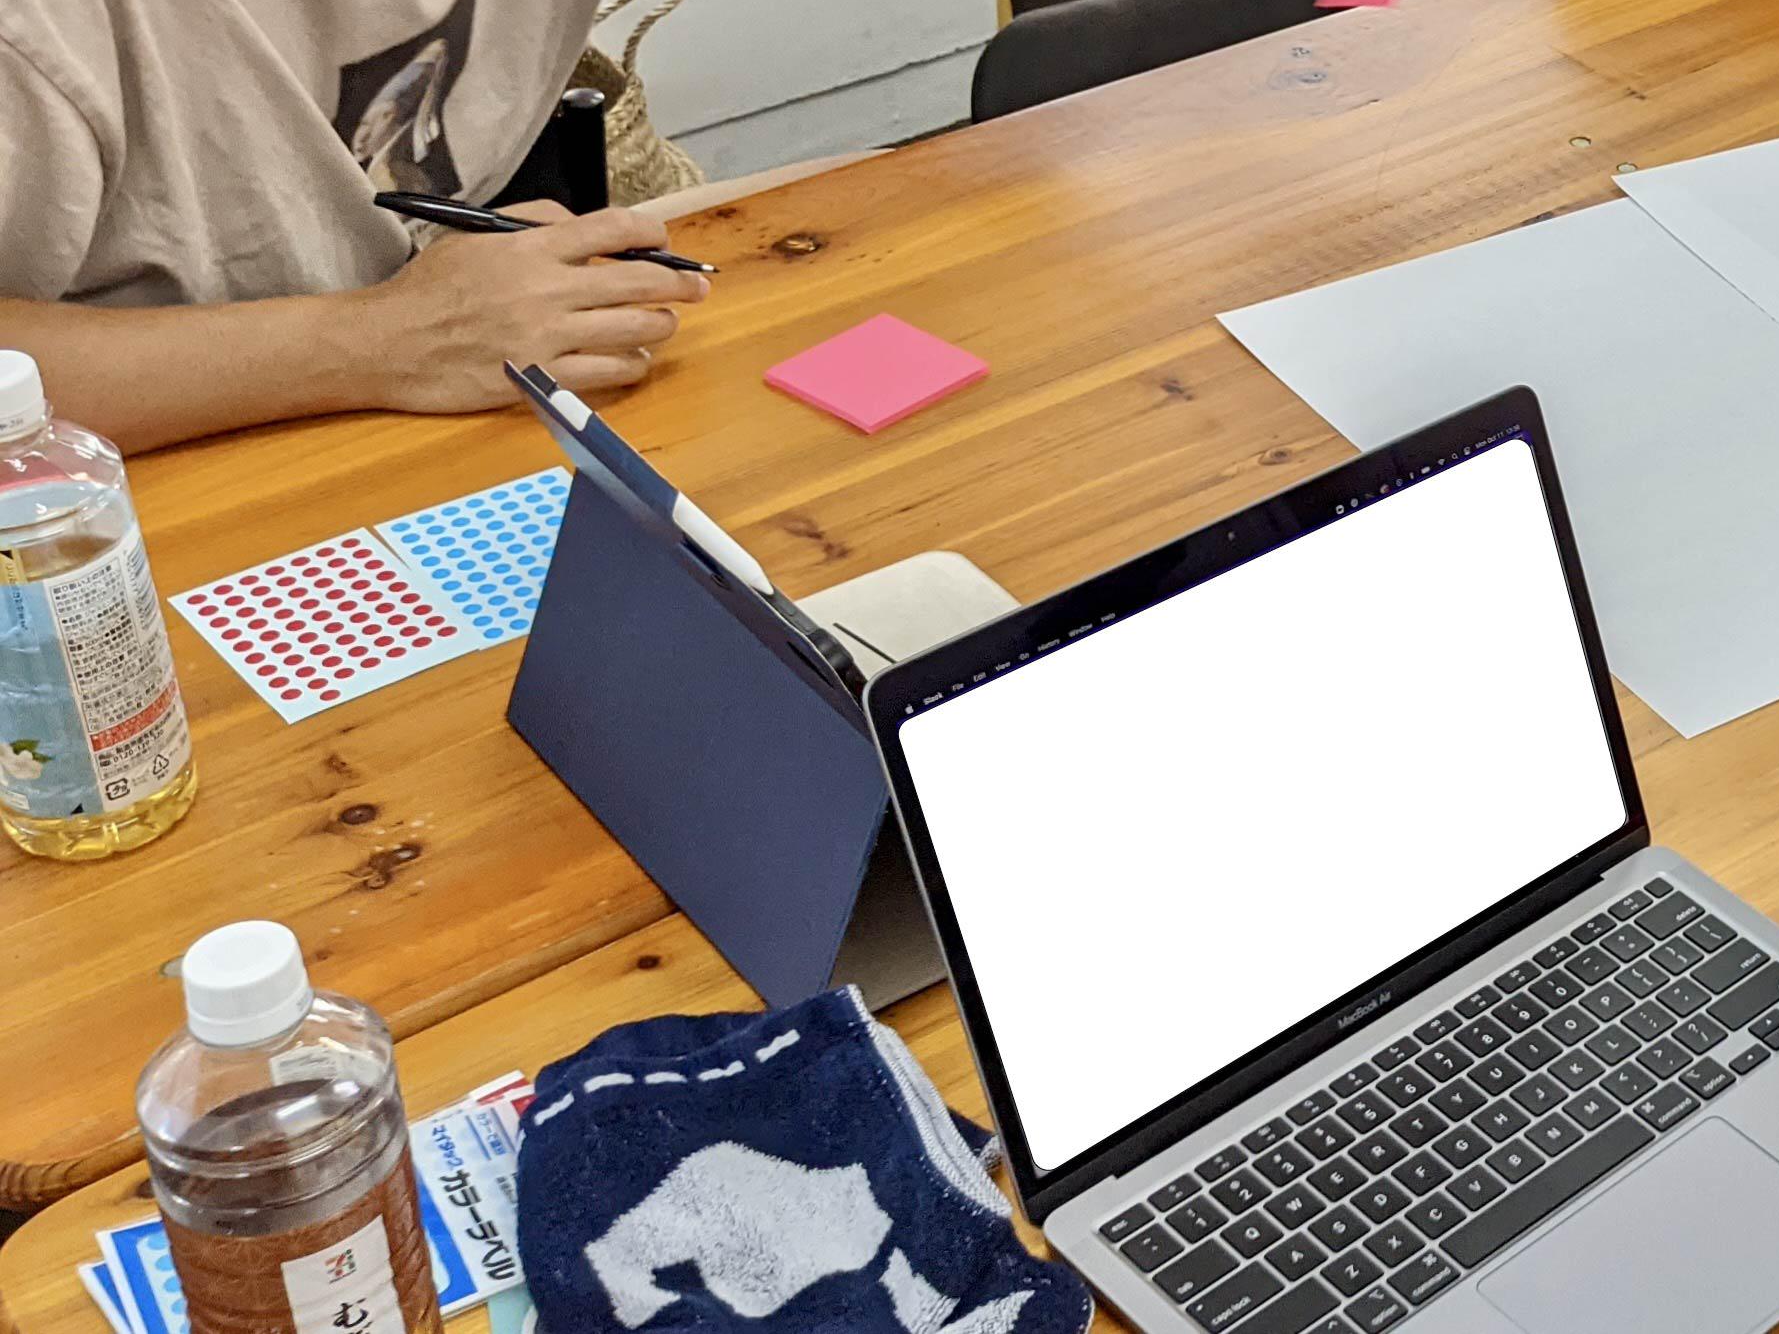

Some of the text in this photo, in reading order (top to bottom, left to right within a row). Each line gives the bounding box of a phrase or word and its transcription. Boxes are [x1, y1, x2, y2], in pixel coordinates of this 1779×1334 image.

[923, 692, 943, 705] Slack
[973, 671, 987, 682] Edit
[995, 661, 1011, 672] View
[1068, 623, 1093, 638] Window
[1338, 991, 1391, 1028] MacBook Air
[1703, 1074, 1727, 1093] option
[432, 1124, 464, 1167] マイタック
[439, 1168, 516, 1281] カラーラベル
[1231, 1296, 1251, 1311] lock
